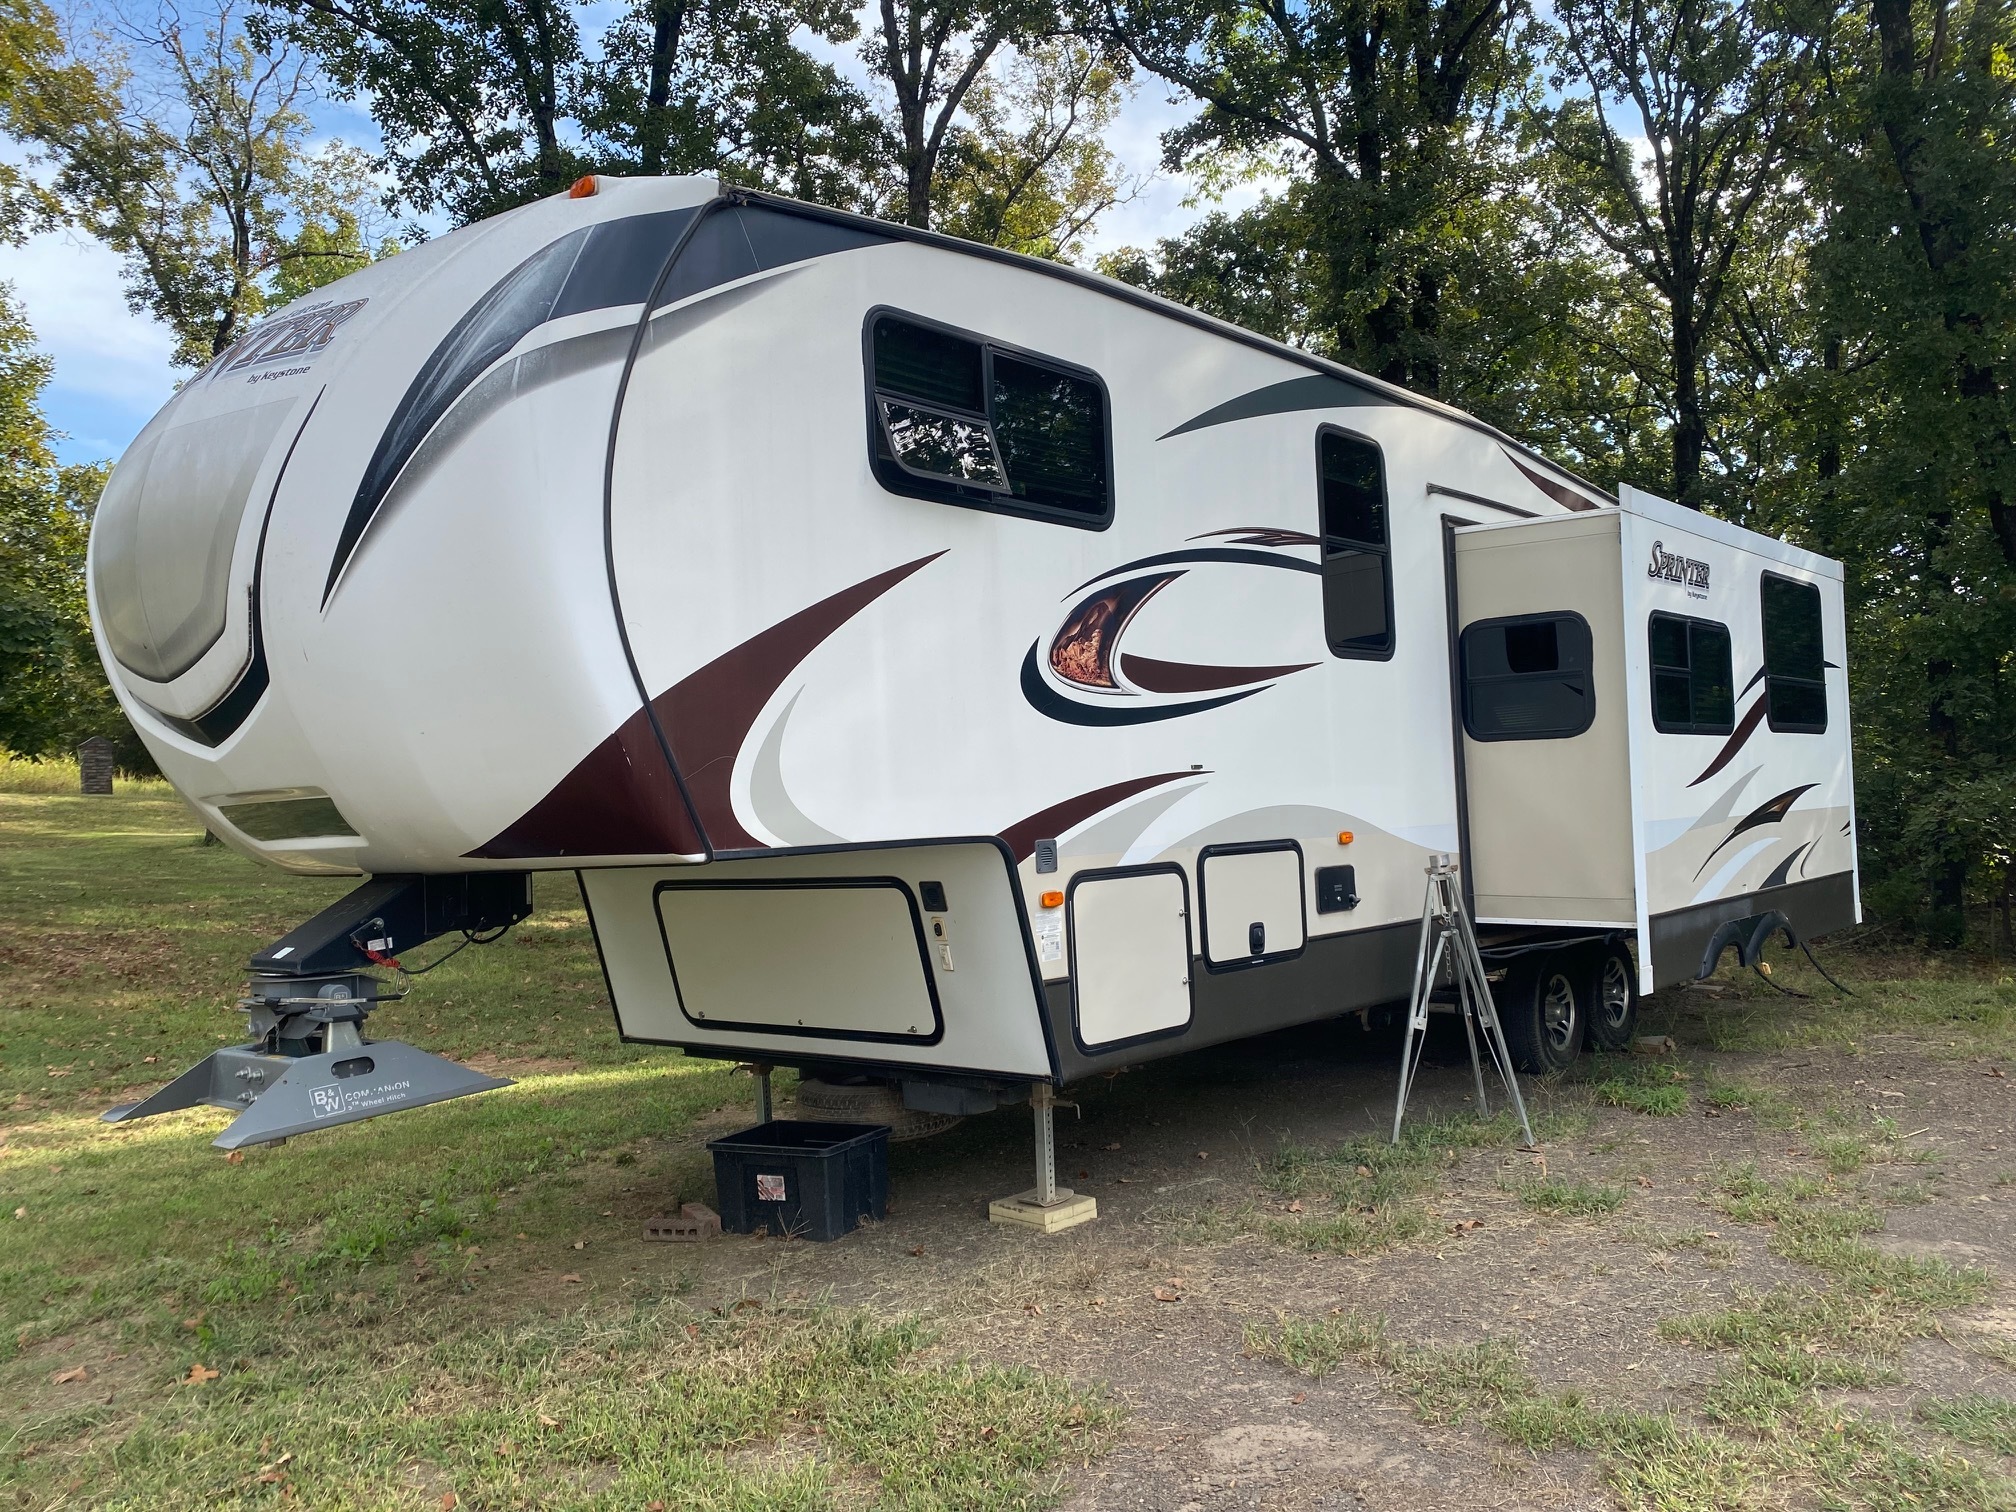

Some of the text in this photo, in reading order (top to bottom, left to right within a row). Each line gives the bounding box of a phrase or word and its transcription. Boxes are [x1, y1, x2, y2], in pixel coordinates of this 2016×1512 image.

[247, 366, 311, 384] by Keystone
[1648, 540, 1710, 590] SPRINTER
[345, 1080, 410, 1101] COMANION
[361, 1097, 385, 1108] Wheel
